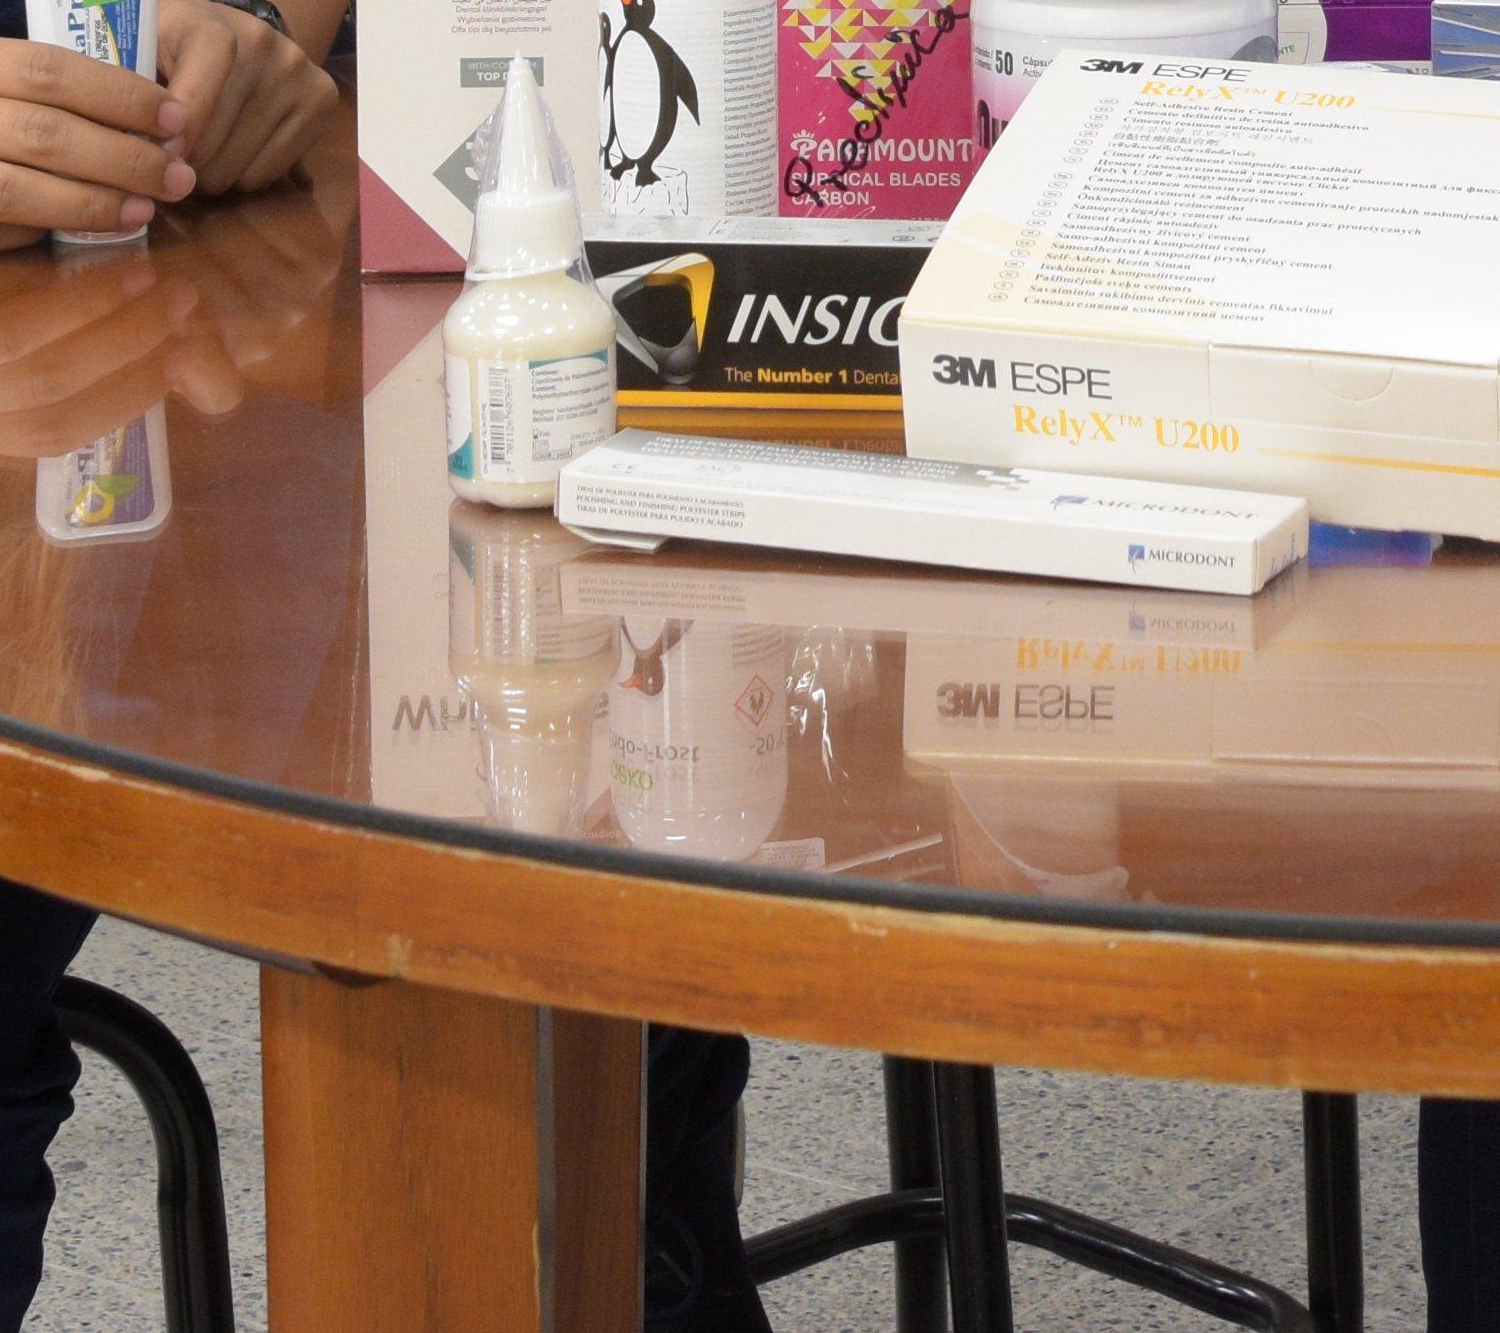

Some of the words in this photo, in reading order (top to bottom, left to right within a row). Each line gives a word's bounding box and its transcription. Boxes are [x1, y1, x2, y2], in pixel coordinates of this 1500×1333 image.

[995, 49, 1014, 76] 50
[1082, 58, 1143, 74] 3M
[1152, 63, 1250, 82] ESPE
[1131, 100, 1209, 114] Self-Adhesive
[1213, 105, 1244, 113] Resin
[1248, 108, 1292, 116] Cement
[1274, 90, 1355, 107] U200
[1125, 108, 1178, 118] Cemento
[1181, 112, 1235, 122] definitivo
[1293, 121, 1368, 130] autoadhesivo
[790, 137, 973, 162] PARAMOUNT
[792, 173, 884, 186] SURGICAL
[890, 172, 961, 186] BLADES
[792, 191, 869, 206] CARBON
[725, 367, 753, 384] The
[757, 368, 833, 384] Number
[838, 369, 848, 384] 1
[932, 353, 997, 391] 3M
[1010, 362, 1112, 400] ESPE
[1155, 418, 1240, 454] U200
[1092, 497, 1257, 520] MICRODONT
[1148, 547, 1236, 569] MICRODONT
